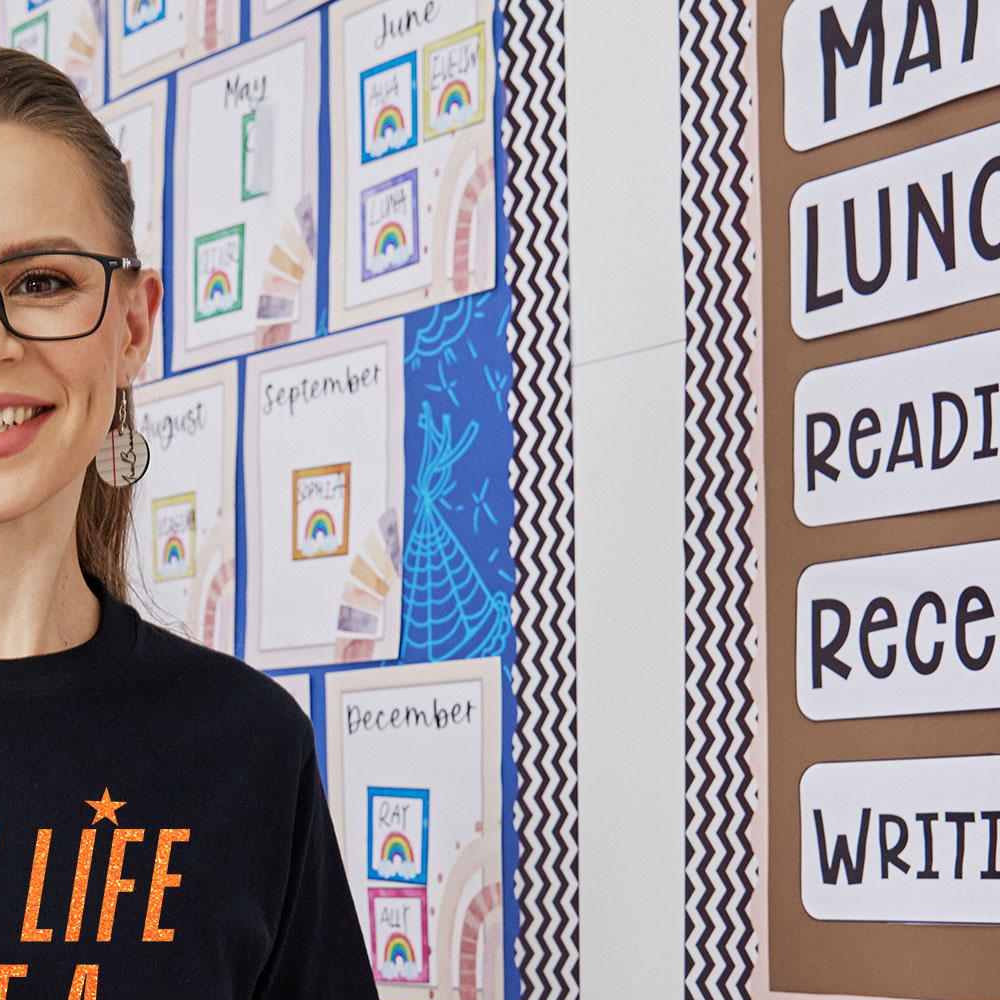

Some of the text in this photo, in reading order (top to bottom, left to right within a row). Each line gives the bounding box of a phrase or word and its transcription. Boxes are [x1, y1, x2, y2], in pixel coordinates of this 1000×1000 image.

[374, 0, 441, 49] June
[224, 75, 267, 109] May
[262, 364, 382, 416] September
[140, 402, 206, 450] August
[346, 697, 477, 735] December
[20, 828, 191, 942] LIFE
